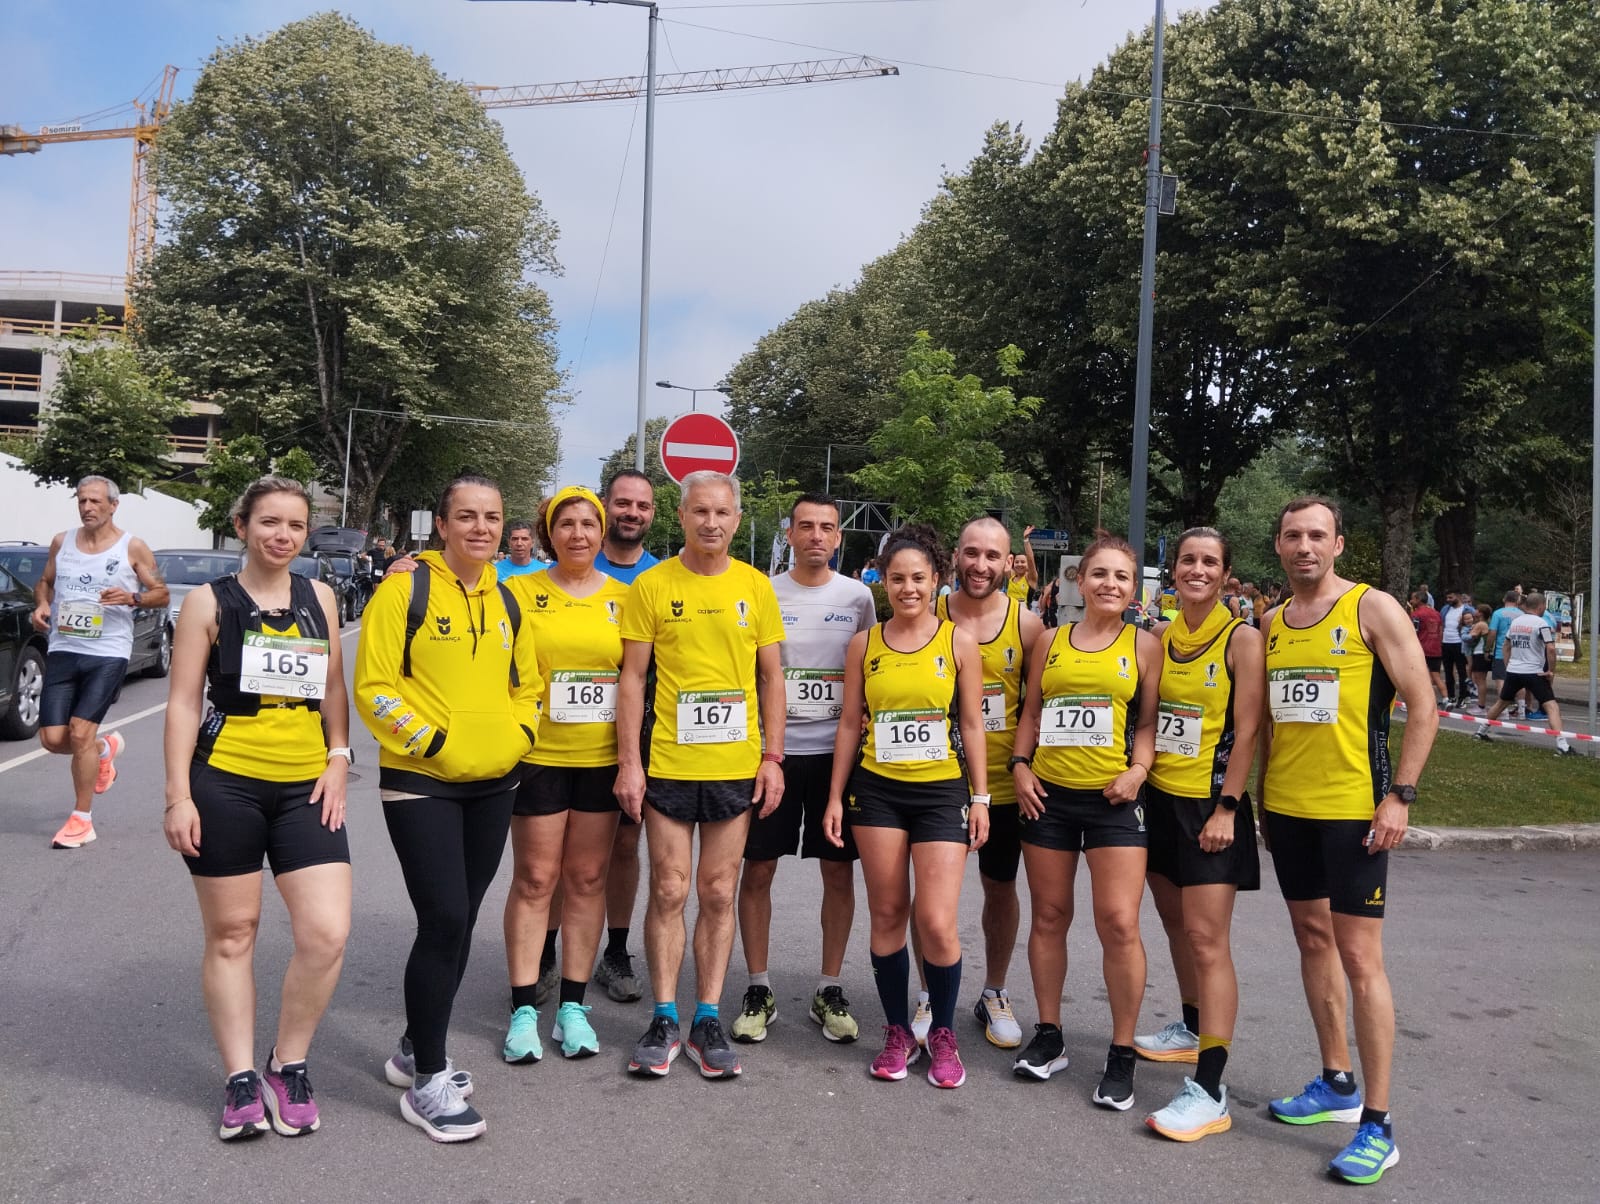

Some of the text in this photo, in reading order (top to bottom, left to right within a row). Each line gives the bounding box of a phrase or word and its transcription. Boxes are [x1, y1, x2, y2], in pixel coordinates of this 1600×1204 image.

[66, 614, 93, 628] 327
[262, 651, 309, 676] 165
[567, 685, 604, 704] 168
[798, 682, 835, 700] 301
[1281, 683, 1319, 703] 169
[693, 705, 732, 725] 167
[1055, 709, 1096, 728] 170
[890, 723, 931, 744] 166
[1156, 715, 1185, 737] 73
